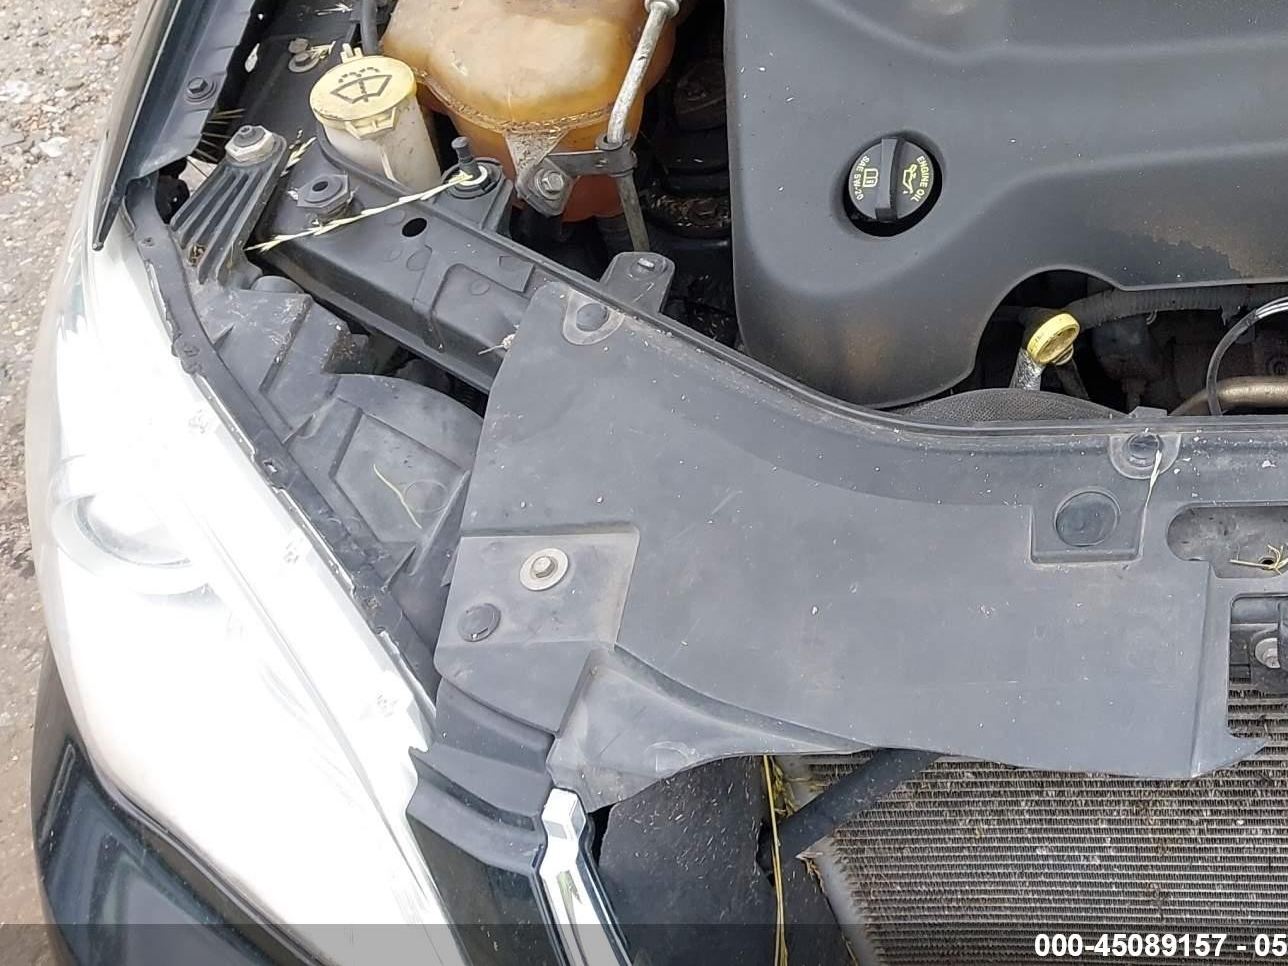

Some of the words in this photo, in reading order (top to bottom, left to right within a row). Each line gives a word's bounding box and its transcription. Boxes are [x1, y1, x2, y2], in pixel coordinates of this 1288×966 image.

[856, 155, 870, 172] SAE
[916, 155, 930, 188] ENGINE
[911, 189, 925, 202] OIL
